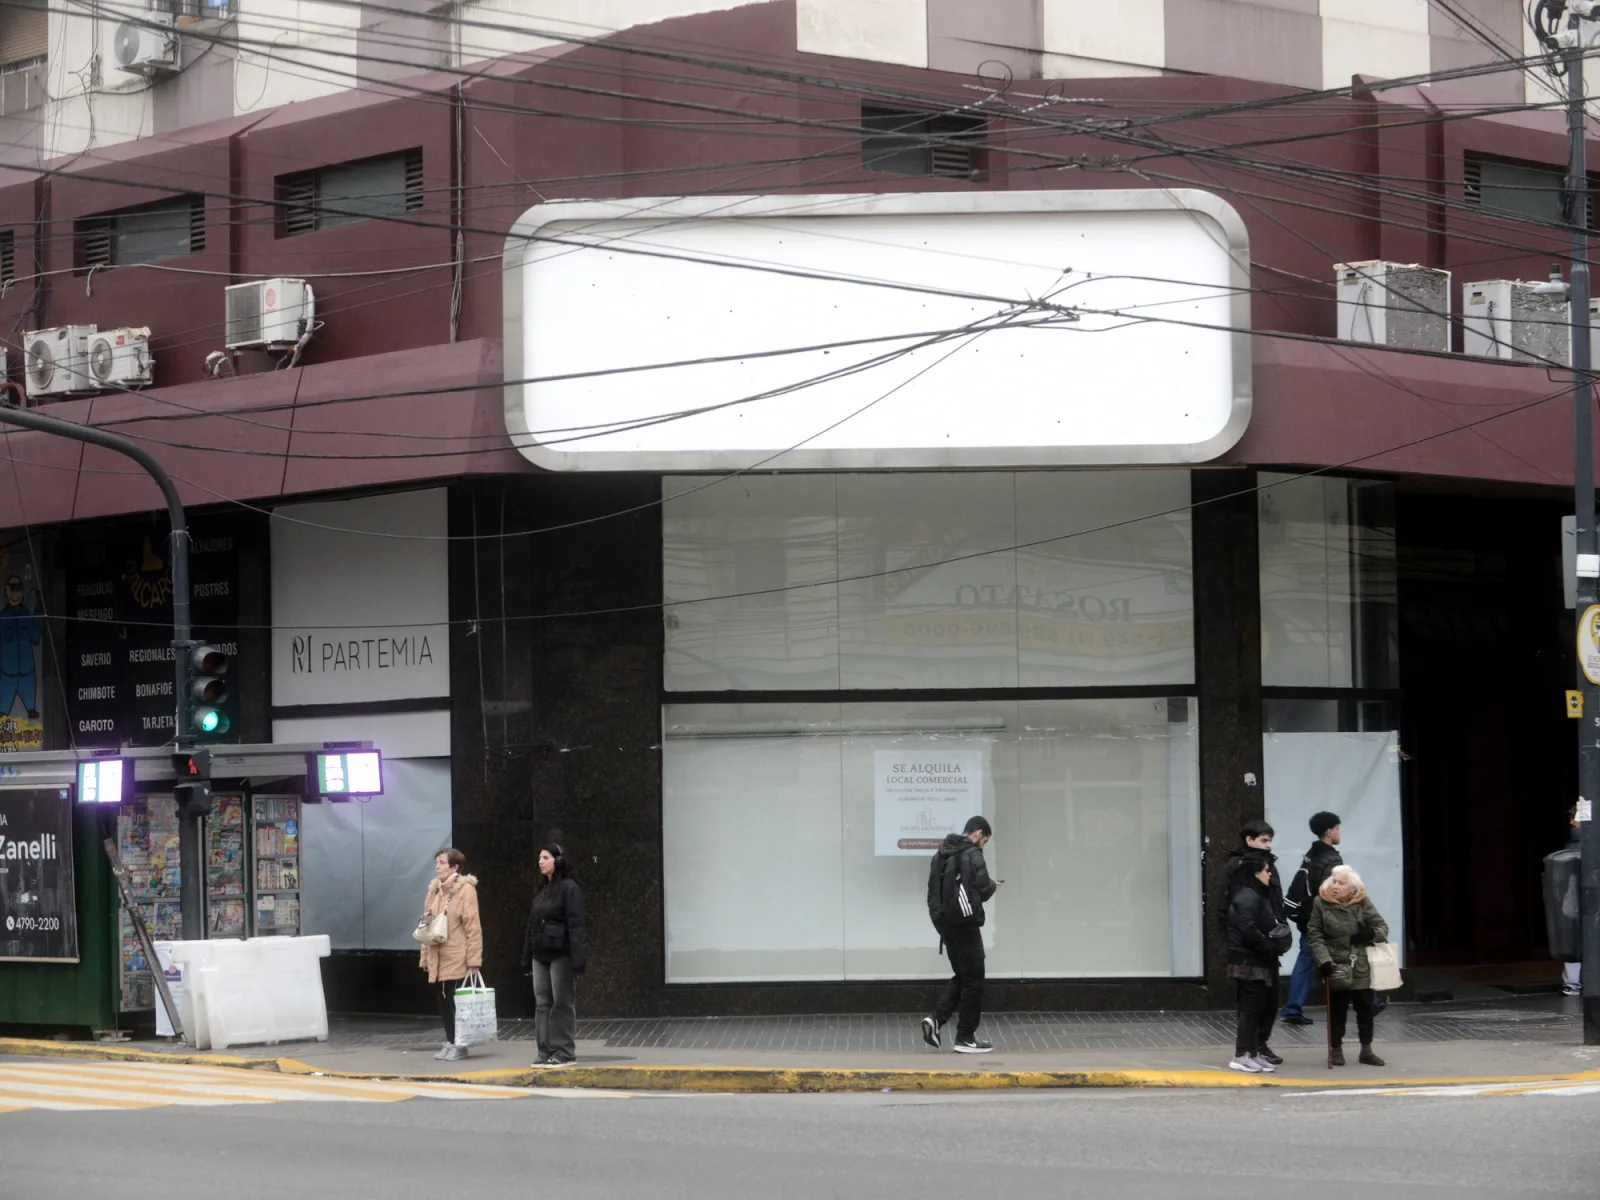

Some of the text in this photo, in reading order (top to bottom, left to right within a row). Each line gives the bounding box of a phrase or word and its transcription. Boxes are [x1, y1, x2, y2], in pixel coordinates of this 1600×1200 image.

[194, 581, 230, 597] POSTRES
[77, 607, 114, 621] MERENGO
[81, 652, 112, 667] SAVERIO
[129, 647, 176, 662] REGIONALES
[321, 635, 434, 673] PARTEMIA
[78, 685, 116, 701] CHIMBOTE
[136, 681, 173, 697] BONAFIDE
[79, 719, 114, 732] GAROTO
[892, 763, 961, 775] SE ALQUILA
[886, 775, 968, 784] LOCAL COMERCIAL
[0, 833, 56, 860] Zanelli
[15, 917, 60, 931] 4790-2200
